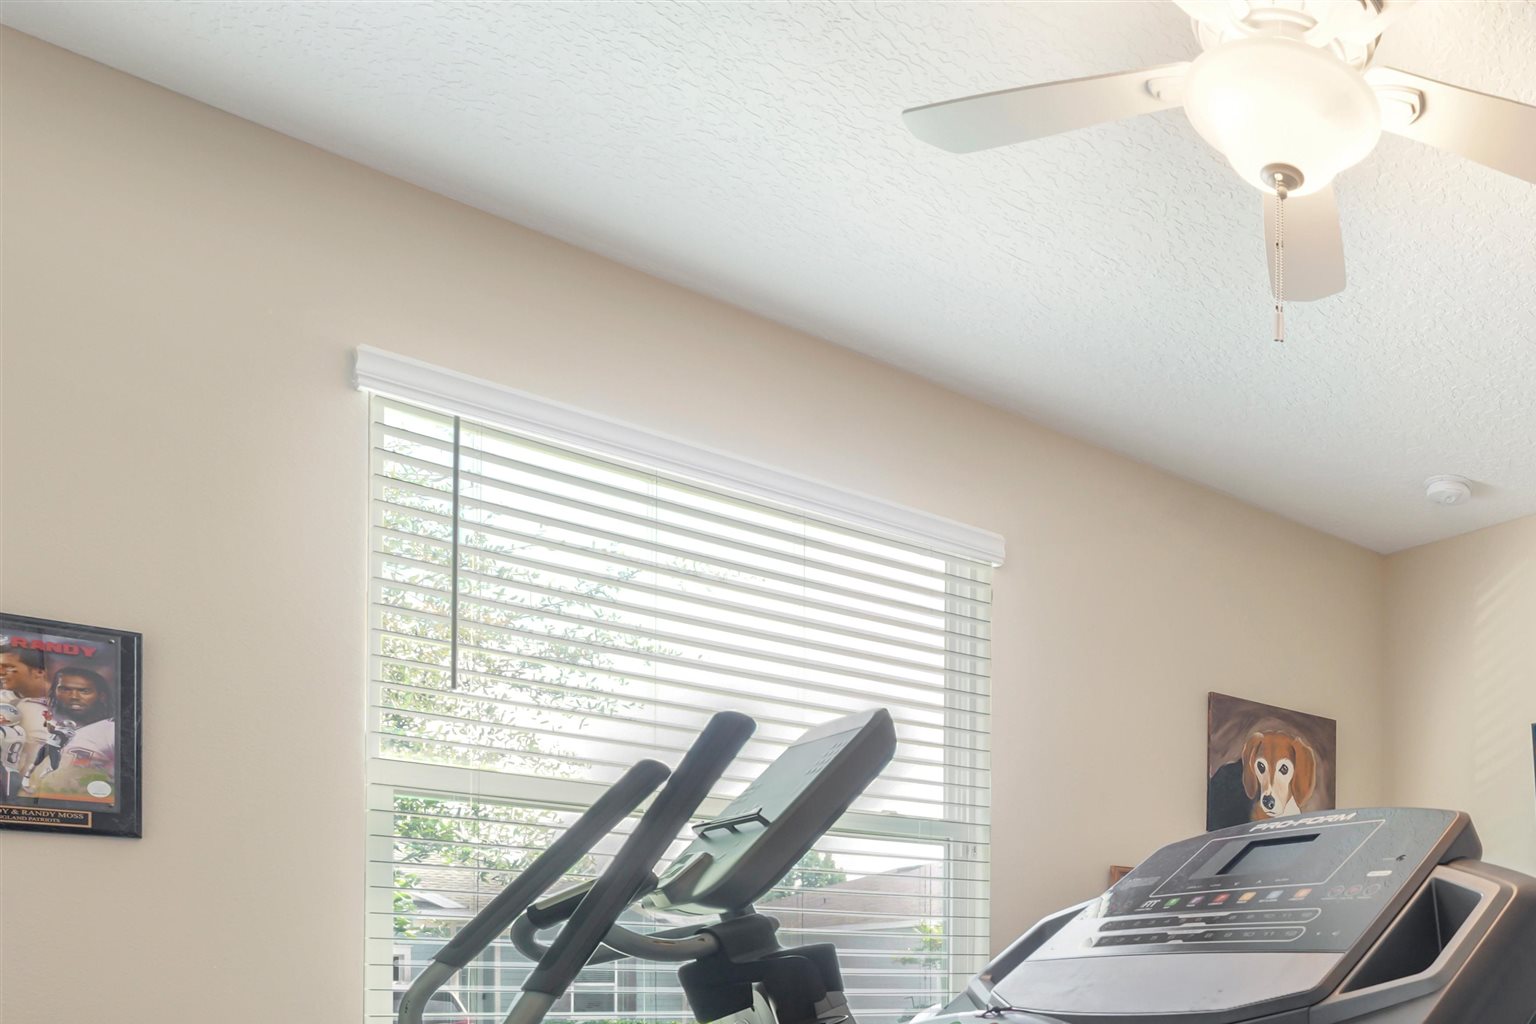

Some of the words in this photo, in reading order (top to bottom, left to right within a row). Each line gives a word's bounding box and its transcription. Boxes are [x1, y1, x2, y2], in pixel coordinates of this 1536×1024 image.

[10, 636, 97, 657] RANDY
[22, 809, 56, 818] RANDY
[58, 812, 84, 820] MOSS
[1249, 812, 1357, 832] PRO-FORM
